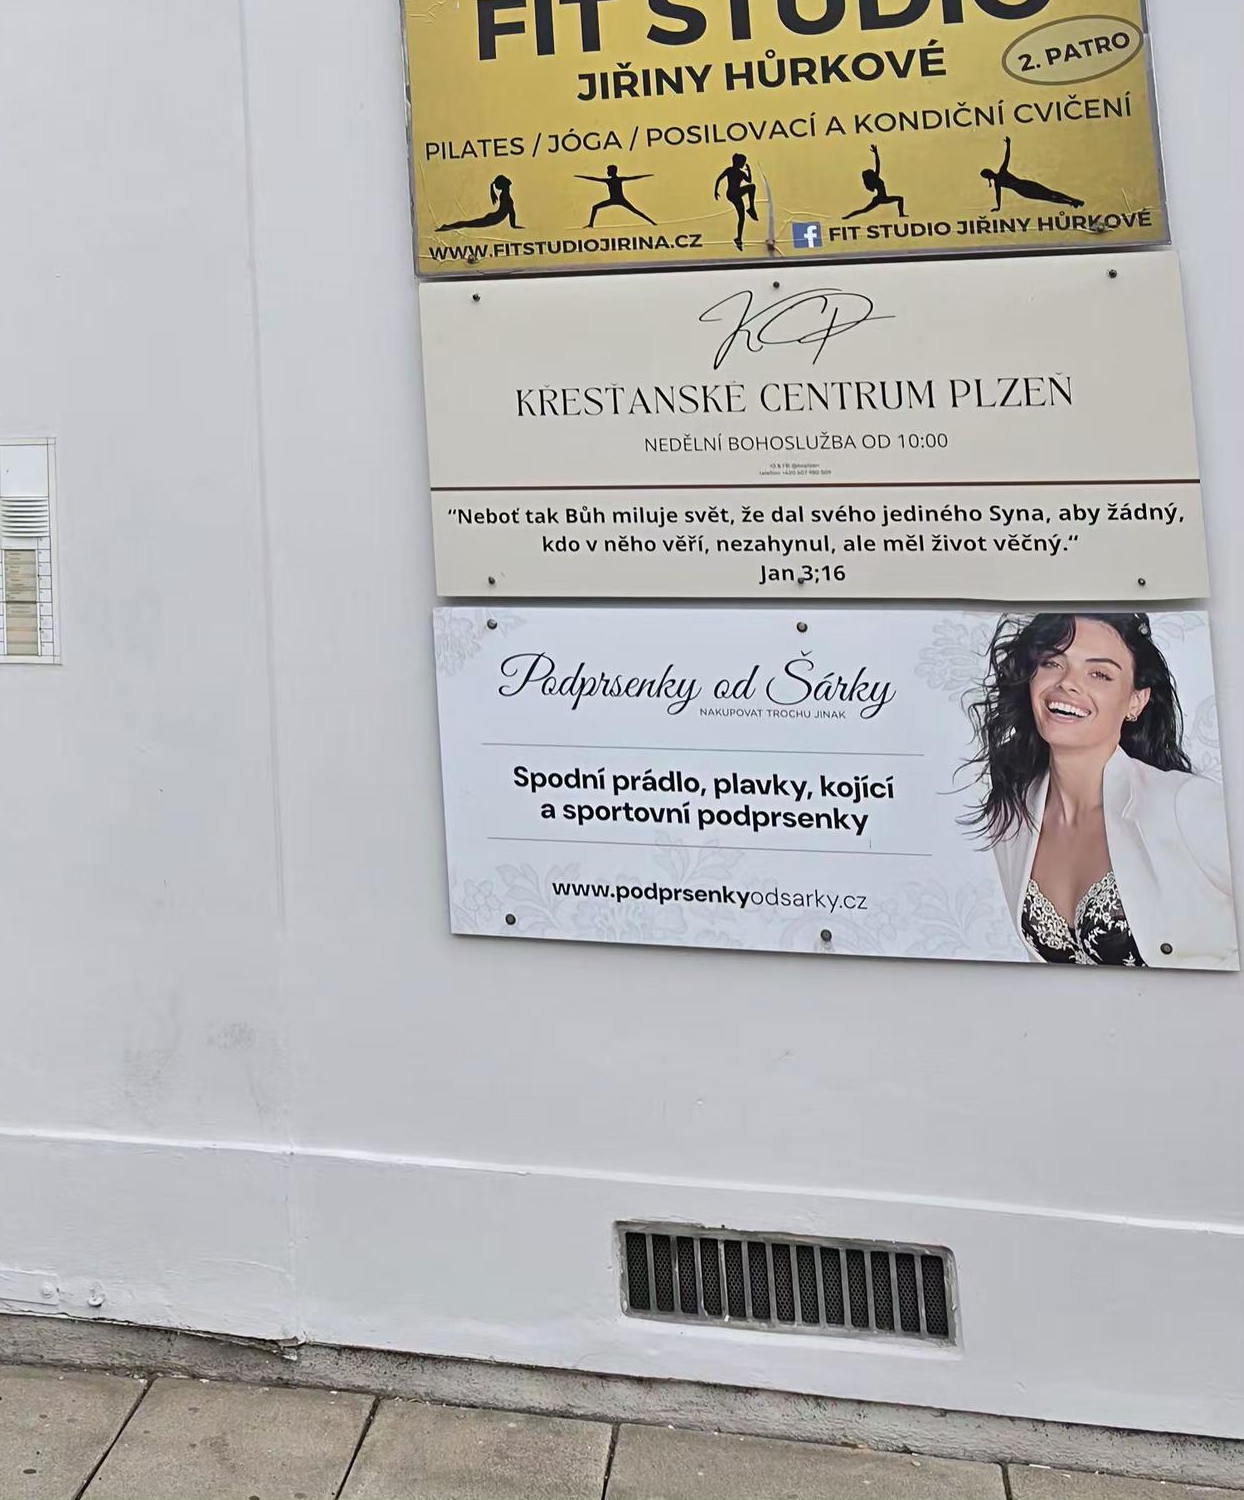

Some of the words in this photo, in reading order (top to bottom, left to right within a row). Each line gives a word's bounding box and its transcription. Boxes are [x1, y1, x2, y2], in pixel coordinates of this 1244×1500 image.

[1018, 52, 1040, 72] 2.
[1047, 31, 1130, 66] PATRO
[577, 61, 710, 101] JIŘINY
[725, 39, 947, 92] HŮRKOVÉ
[425, 135, 524, 160] PILATES
[547, 123, 622, 154] JÓGA
[646, 112, 817, 147] POSILOVACÍ
[825, 116, 847, 135] A
[855, 100, 1005, 133] KONDIČNÍ
[1015, 92, 1132, 124] CVIČENÍ
[829, 225, 860, 241] FIT
[866, 221, 951, 239] STUDIO
[957, 214, 1030, 236] JIŘINY
[1037, 207, 1152, 232] HŮRKOVÉ
[429, 232, 702, 261] WWW.FITSTUDIOJIRINA.CZ
[760, 379, 935, 412] CENTRUM
[948, 372, 1074, 408] PLZEŇ
[644, 432, 722, 452] NEDĚLNÍ
[728, 431, 856, 451] BOHOSLUŽBA
[862, 433, 890, 449] OD
[897, 432, 948, 449] 10:00
[525, 507, 560, 524] tak
[565, 504, 607, 524] Bůh
[612, 506, 679, 528] miluje
[684, 506, 735, 526] svět,
[741, 504, 766, 522] že
[771, 504, 804, 522] dal
[810, 502, 877, 522] svého
[883, 502, 983, 527] jediného
[988, 504, 1052, 527] Syna,
[1058, 503, 1101, 526] aby
[1107, 502, 1185, 526] žádný,
[542, 535, 581, 552] kdo
[586, 539, 598, 552] v
[604, 534, 657, 552] něho
[663, 534, 710, 555] věří,
[716, 534, 837, 558] nezahynul,
[843, 534, 876, 552] ale
[883, 534, 925, 552] měl
[931, 534, 987, 552] život
[759, 564, 796, 585] Jan
[801, 564, 846, 585] 3;16
[498, 653, 701, 715] Podprsenky
[714, 662, 759, 700] od
[766, 651, 897, 719] Šárky
[700, 708, 763, 717] NAKUPOVAT
[766, 709, 811, 718] TROCHU
[814, 710, 845, 719] JINAK
[513, 765, 606, 795] Spodní
[613, 769, 707, 800] prádlo,
[714, 773, 813, 802] plavky,
[820, 774, 894, 803] kojící
[540, 804, 556, 820] a
[563, 799, 692, 829] sportovní
[698, 804, 869, 835] podprsenky
[552, 880, 867, 911] www.podprsenkyodsarky.cz
